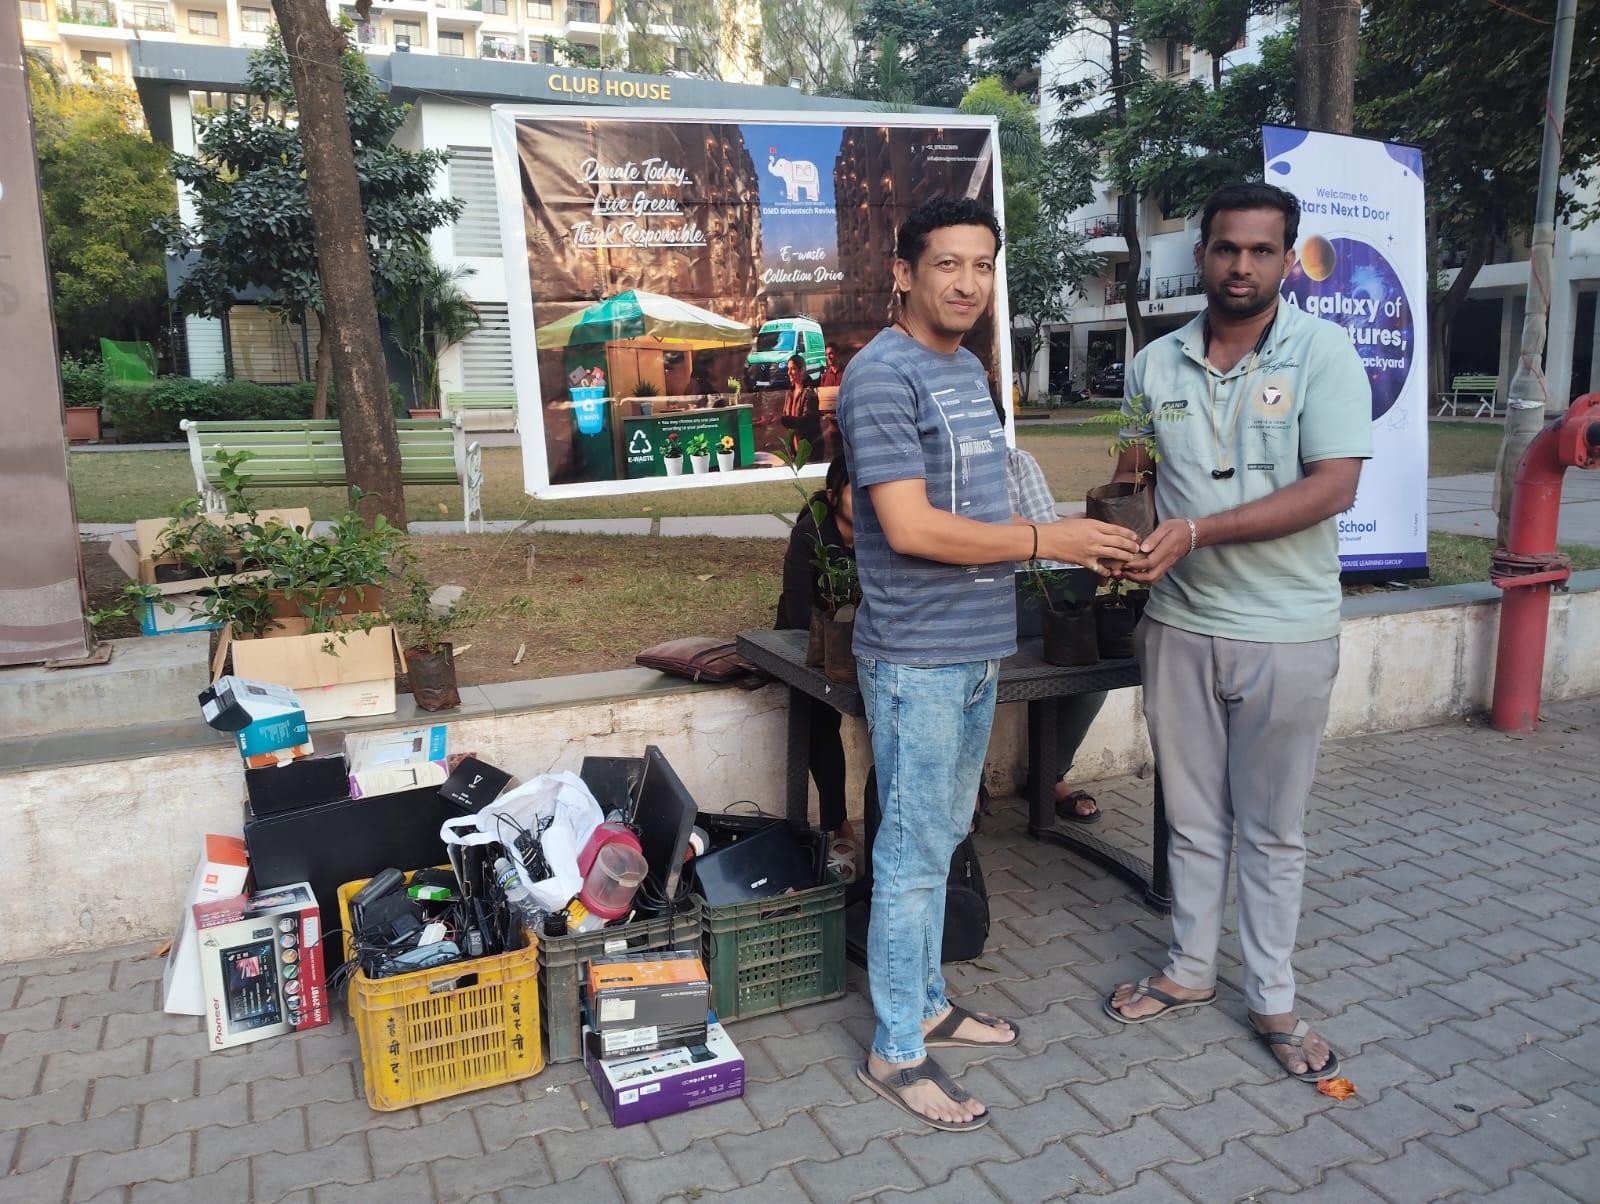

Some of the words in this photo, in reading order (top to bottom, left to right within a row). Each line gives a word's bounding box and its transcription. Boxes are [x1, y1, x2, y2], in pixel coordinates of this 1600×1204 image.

[548, 74, 599, 95] CLUB
[605, 79, 671, 101] HOUSE
[580, 157, 640, 181] Donate
[641, 157, 689, 186] Today.
[593, 190, 629, 213] Live
[631, 191, 680, 217] Green.
[1316, 188, 1357, 201] Welcome
[1360, 192, 1368, 202] to
[1301, 200, 1327, 214] tars
[1331, 203, 1359, 217] Next
[1362, 206, 1390, 221] Door
[571, 221, 616, 246] Think
[619, 221, 707, 247] Responsible.
[763, 267, 813, 285] Collection
[814, 266, 845, 283] Drive
[1148, 304, 1164, 313] E-14
[1306, 292, 1380, 322] galaxy
[1384, 296, 1401, 318] of
[1348, 323, 1407, 351] tures,
[1361, 356, 1404, 371] ackyard
[627, 455, 654, 463] E-WASTE
[1339, 520, 1376, 533] School
[213, 997, 224, 1045] Pioneer
